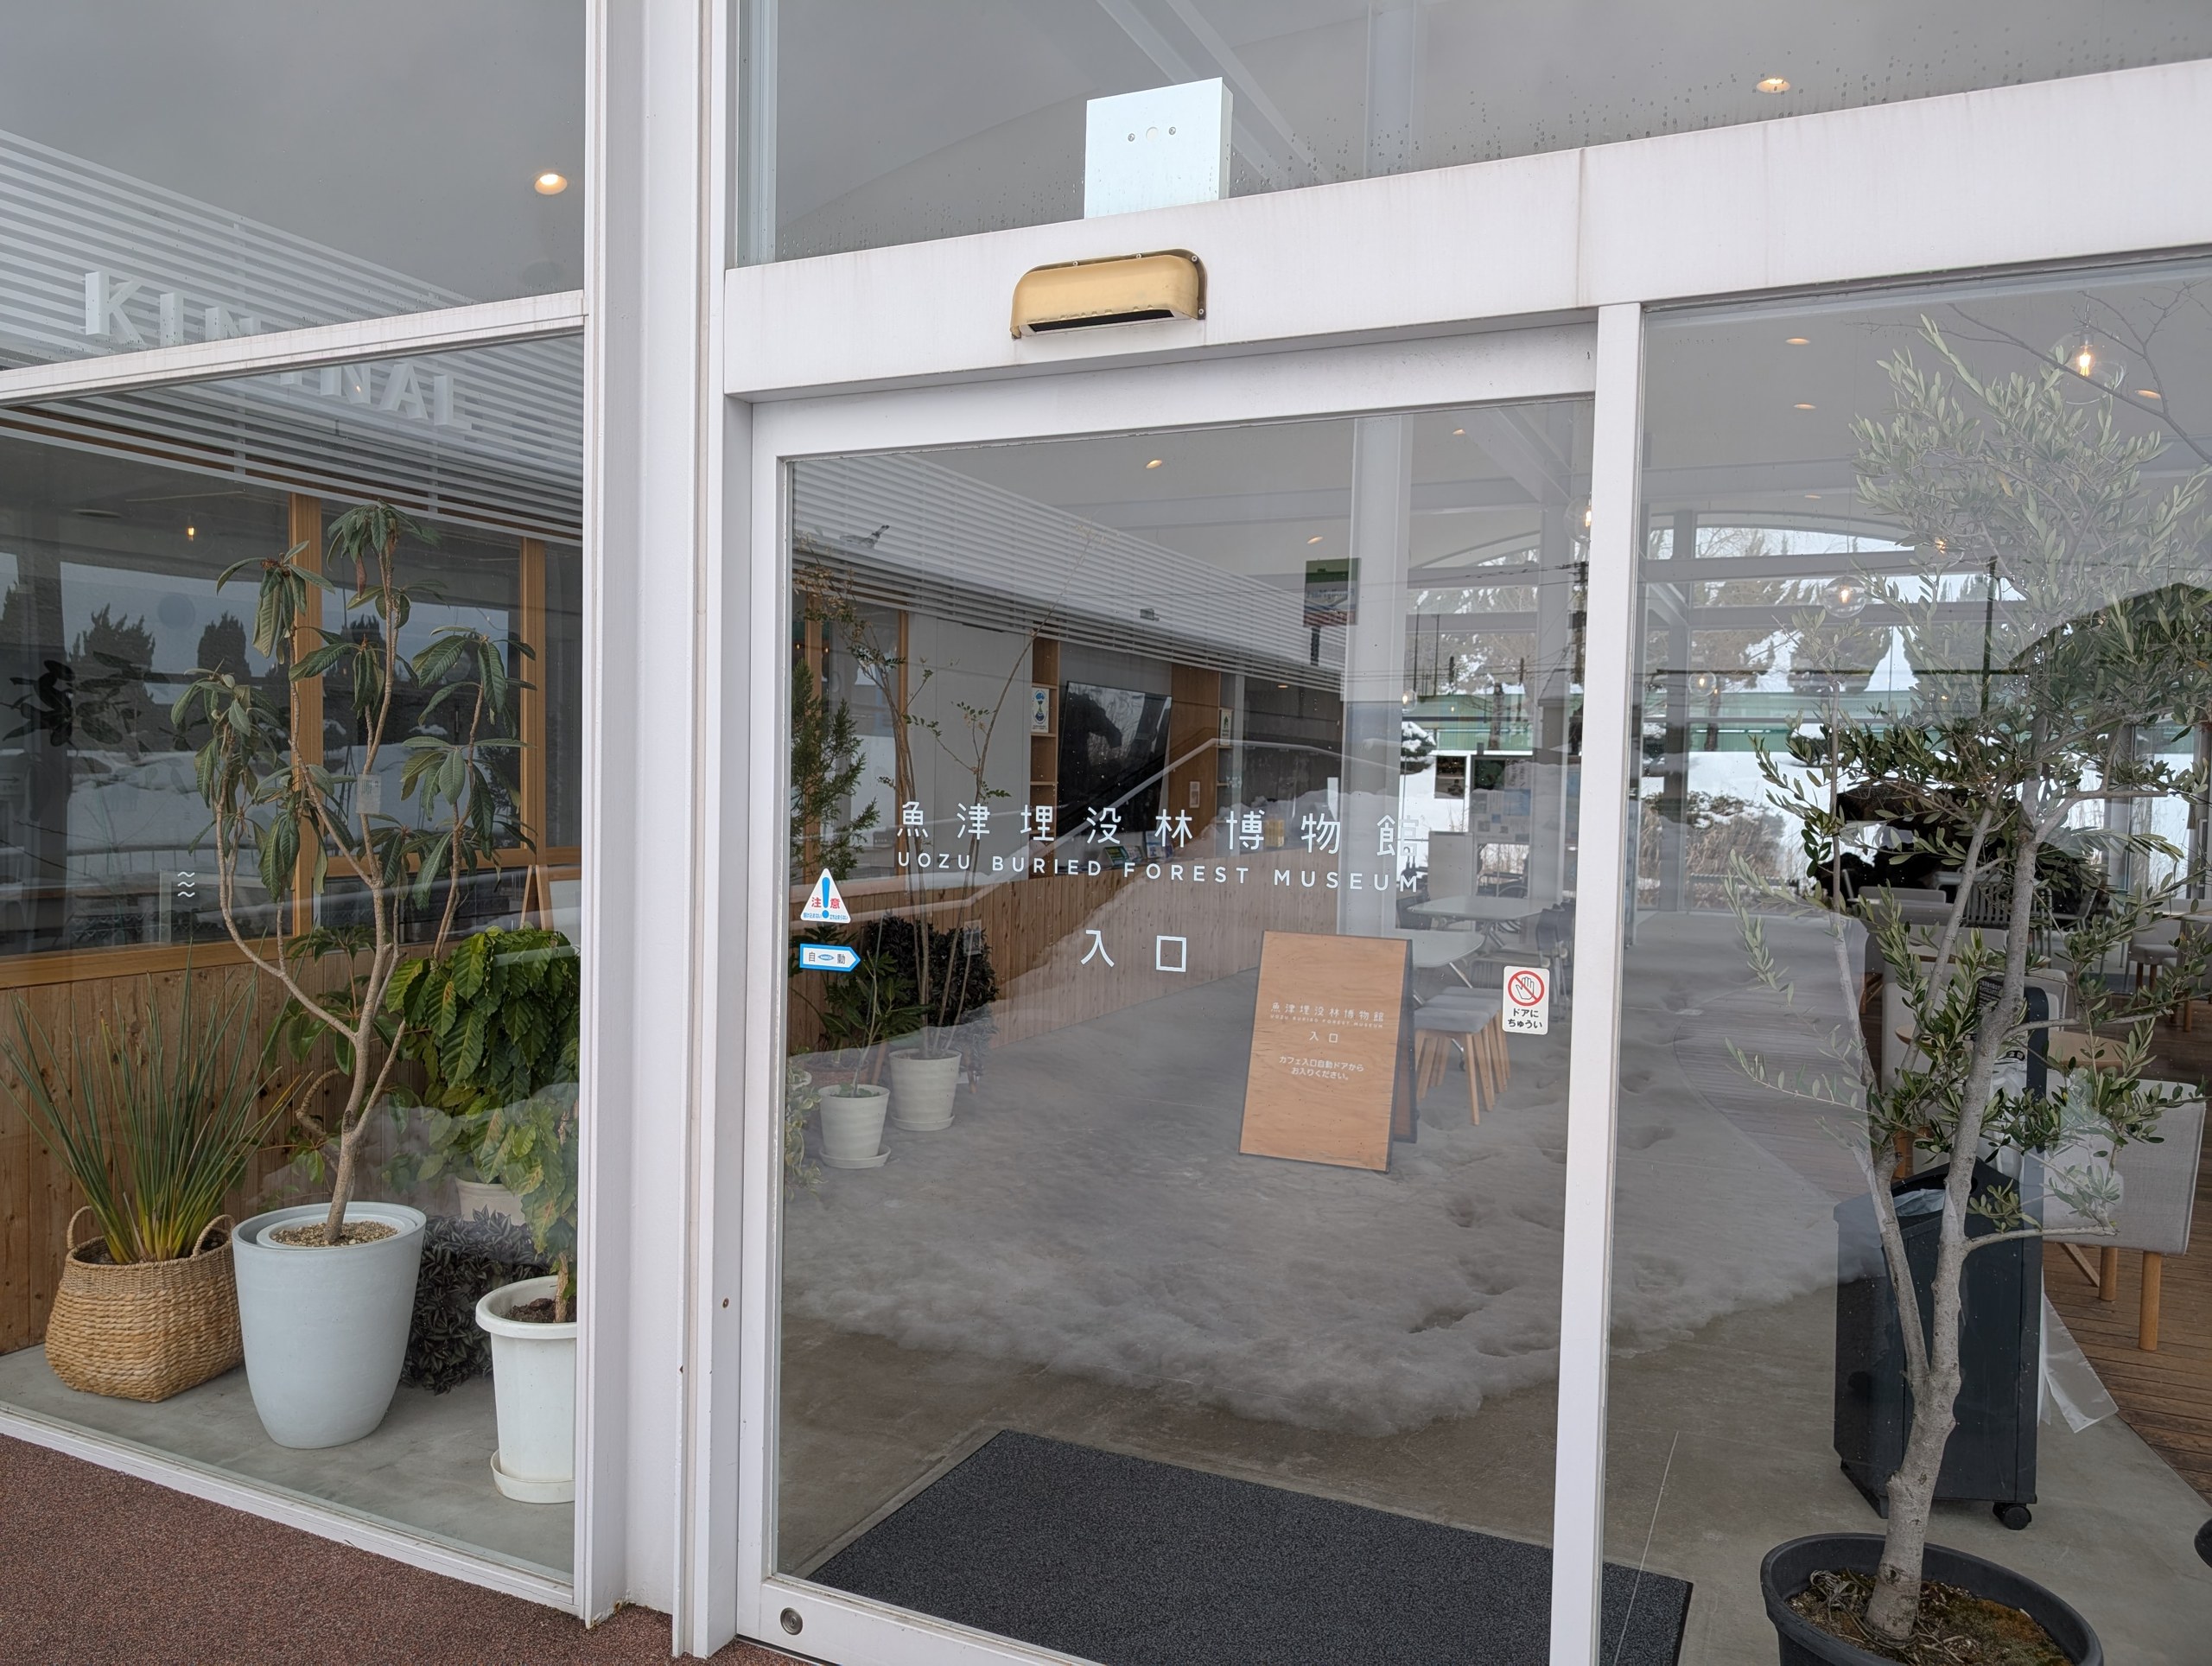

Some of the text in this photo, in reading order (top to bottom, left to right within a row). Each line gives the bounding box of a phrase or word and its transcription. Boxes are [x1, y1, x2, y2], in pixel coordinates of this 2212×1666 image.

[84, 270, 474, 430] KINNAL
[897, 801, 1419, 856] 魚津埋没林博物館
[898, 851, 1417, 893] UOZU BURIED FOREST MUSEUM
[1080, 930, 1186, 972] 入口
[1270, 1002, 1384, 1022] 魚津埋没林博物館
[1513, 1008, 1539, 1018] ドアに
[1507, 1018, 1542, 1029] ちゅうい
[1309, 1031, 1338, 1043] 入口
[1279, 1056, 1364, 1071] カフェ入口自動ドアから
